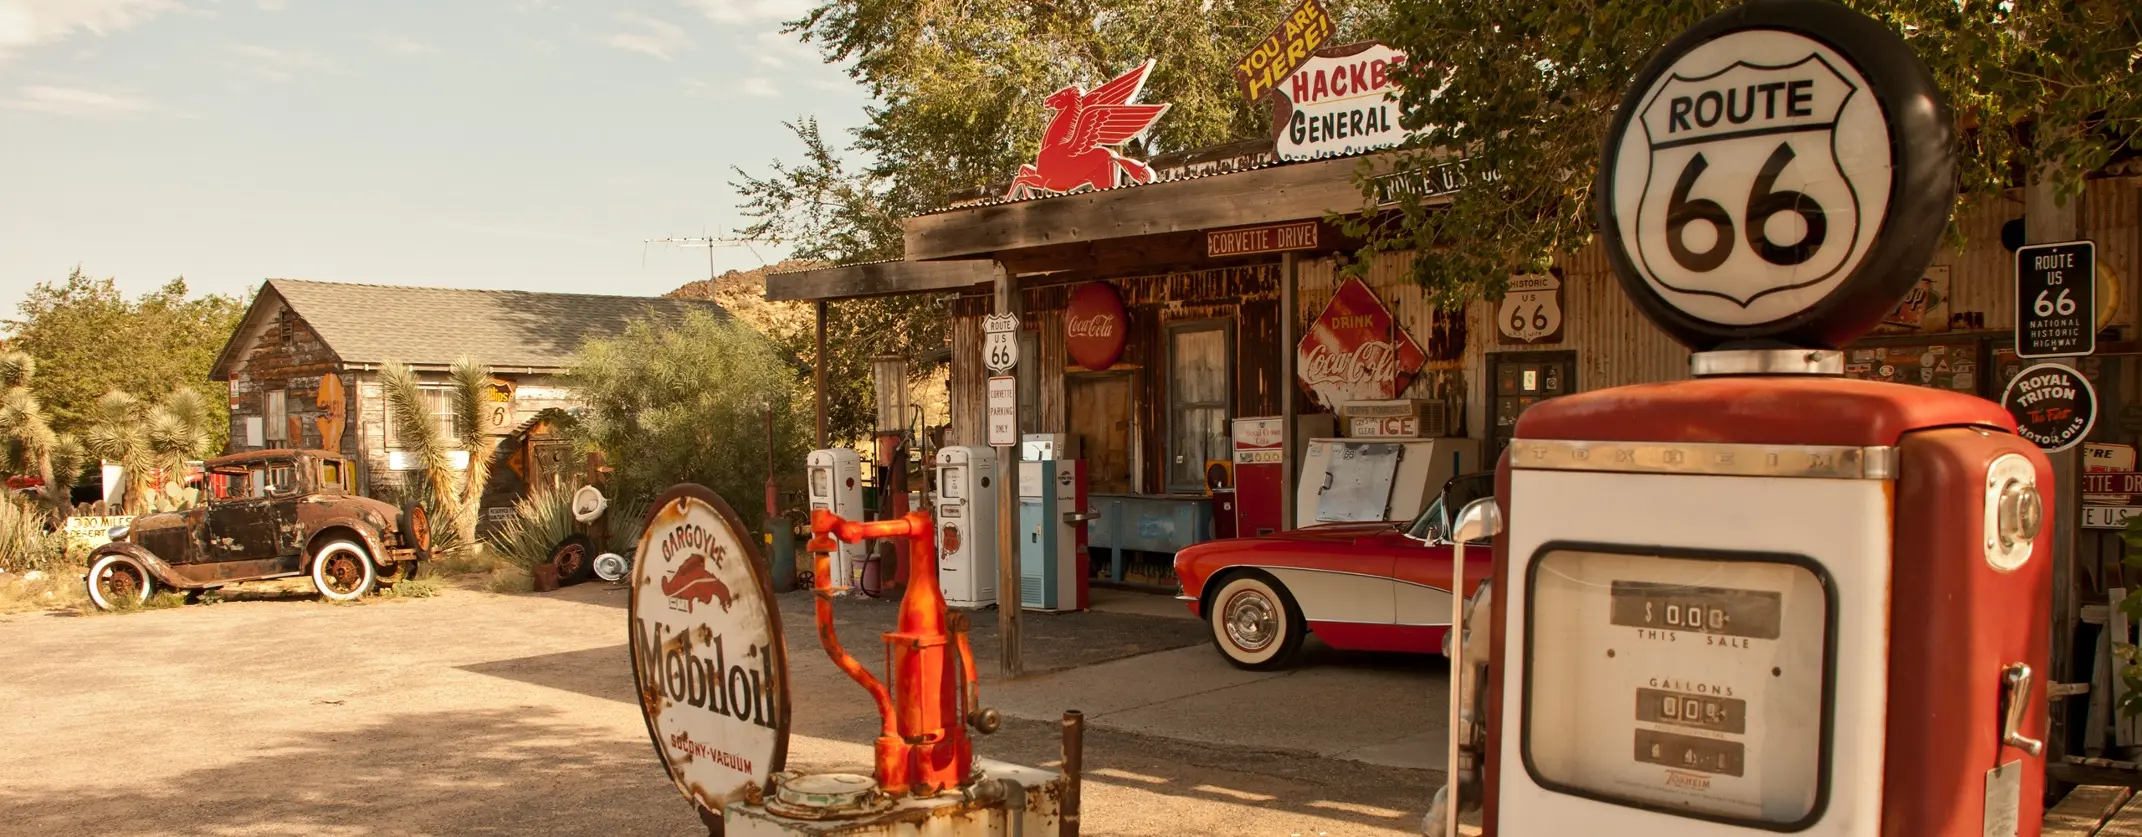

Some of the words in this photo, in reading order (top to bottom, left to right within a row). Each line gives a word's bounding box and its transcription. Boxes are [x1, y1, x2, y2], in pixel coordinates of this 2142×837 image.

[1239, 37, 1280, 77] YOU
[1285, 0, 1318, 41] ARE
[1249, 15, 1328, 100] HERE!
[1669, 79, 1814, 133] ROUTE
[1289, 105, 1391, 146] GENERAL
[1666, 141, 1827, 273] 66
[1213, 229, 1269, 254] CORVETTE
[1277, 225, 1312, 248] DRIVE
[2034, 253, 2074, 271] ROUTE
[1510, 278, 1549, 289] HISTORIC
[2047, 270, 2063, 286] US
[1521, 294, 1536, 302] US
[2034, 288, 2076, 317] 66
[990, 320, 1011, 331] ROUTE
[1331, 314, 1374, 330] DRINK
[1510, 304, 1548, 331] 66
[2029, 318, 2080, 328] NATIONAL
[994, 334, 1006, 343] US
[2030, 328, 2079, 338] HISTORIC
[2033, 338, 2077, 348] HIGHWAY
[991, 345, 1010, 365] 66
[2018, 374, 2070, 393] ROYAL
[990, 389, 1013, 399] CORVETTE
[2016, 387, 2076, 408] TRITON
[990, 407, 1013, 416] PARKING
[995, 425, 1009, 434] ONLY
[1358, 427, 1376, 435] CLEAR
[1379, 416, 1414, 436] ICE
[2017, 424, 2060, 444] MOTOR
[2061, 415, 2084, 440] OILS
[1532, 446, 1832, 469] TOKHEIM
[662, 524, 726, 570] GARGOYLE
[1637, 628, 1677, 642] THIS
[1706, 635, 1750, 649] SALE
[637, 617, 777, 730] Mobiloil
[1649, 677, 1734, 697] GALLONS
